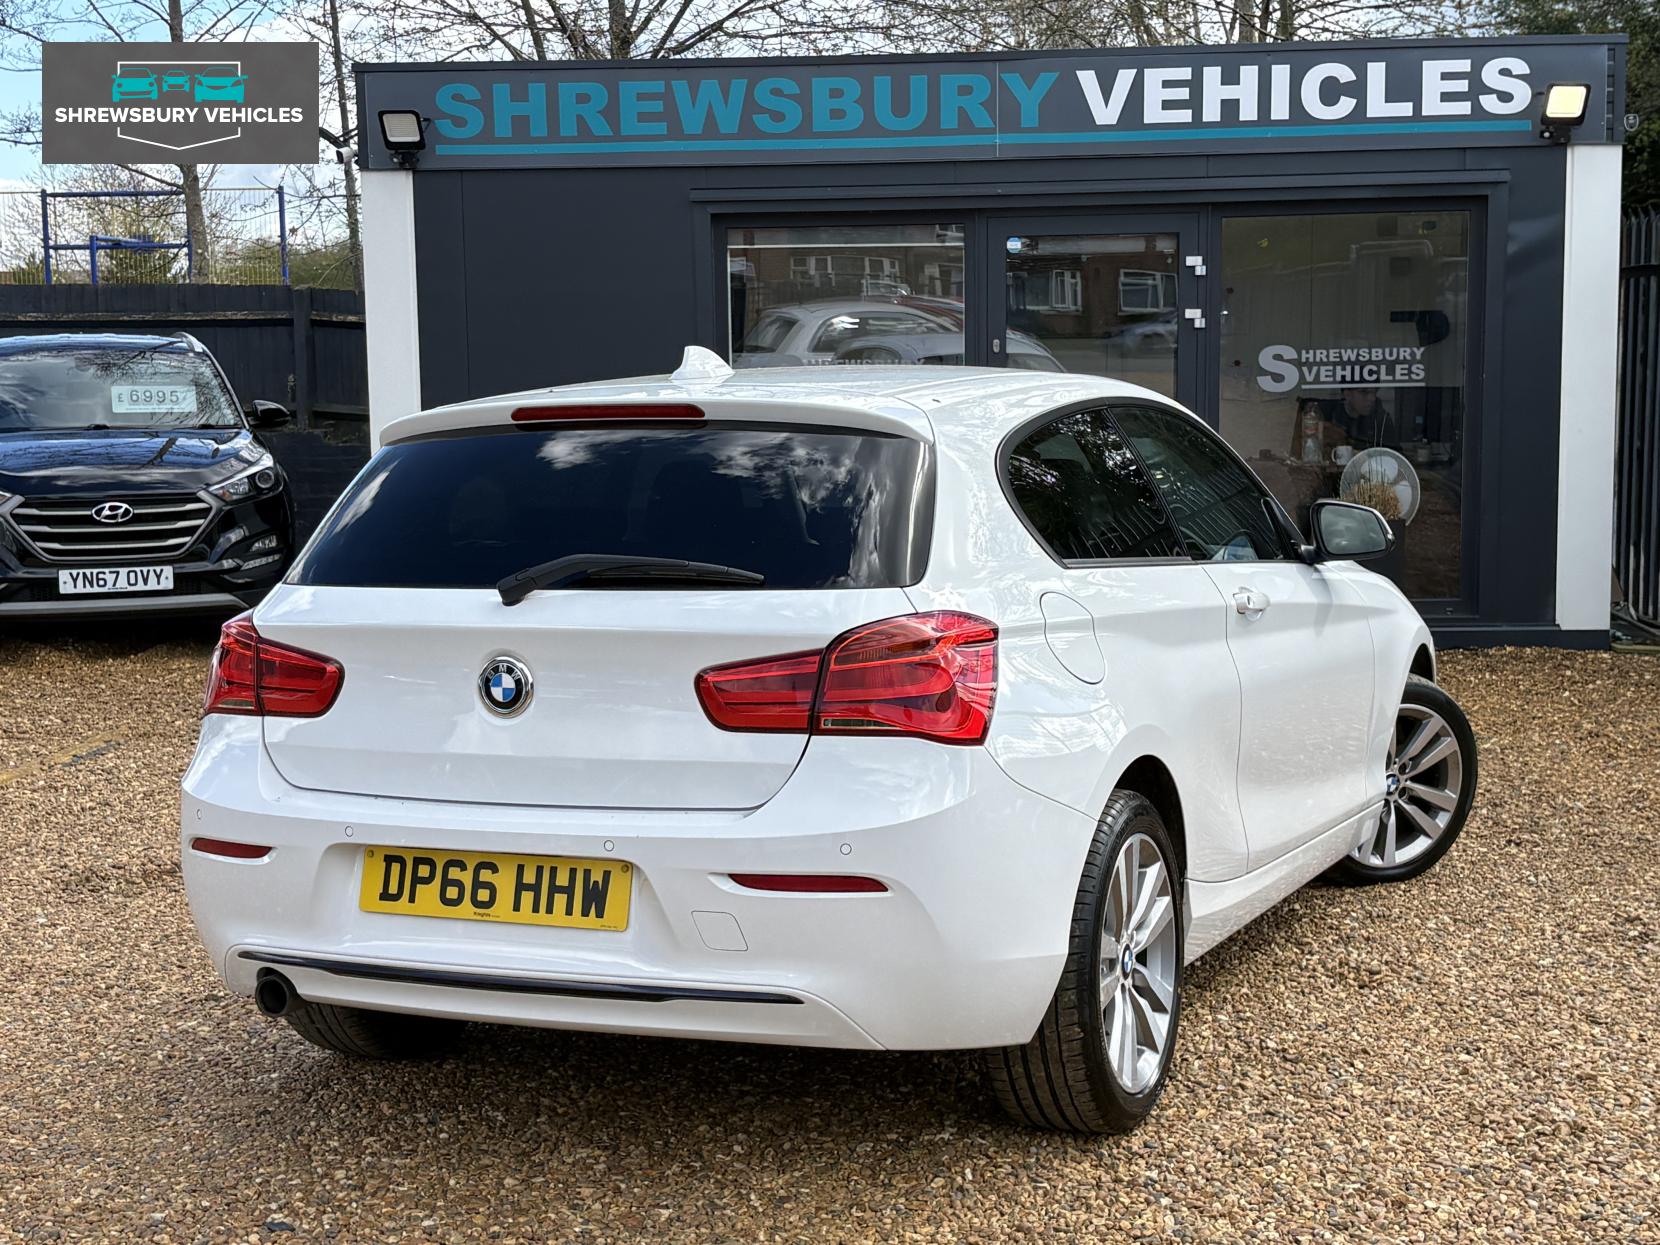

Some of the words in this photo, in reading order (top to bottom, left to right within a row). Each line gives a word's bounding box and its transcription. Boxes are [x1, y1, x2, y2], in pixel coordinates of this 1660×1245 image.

[435, 71, 1060, 139] SHREWSBURY
[1076, 56, 1532, 125] VEHICLES
[1256, 344, 1426, 393] SHREWSBURY
[1301, 364, 1425, 383] VEHICLES
[129, 390, 180, 404] 6995
[69, 570, 121, 589] YN67
[126, 568, 164, 587] OVY
[378, 853, 500, 910] DP66
[512, 863, 612, 919] HHW
